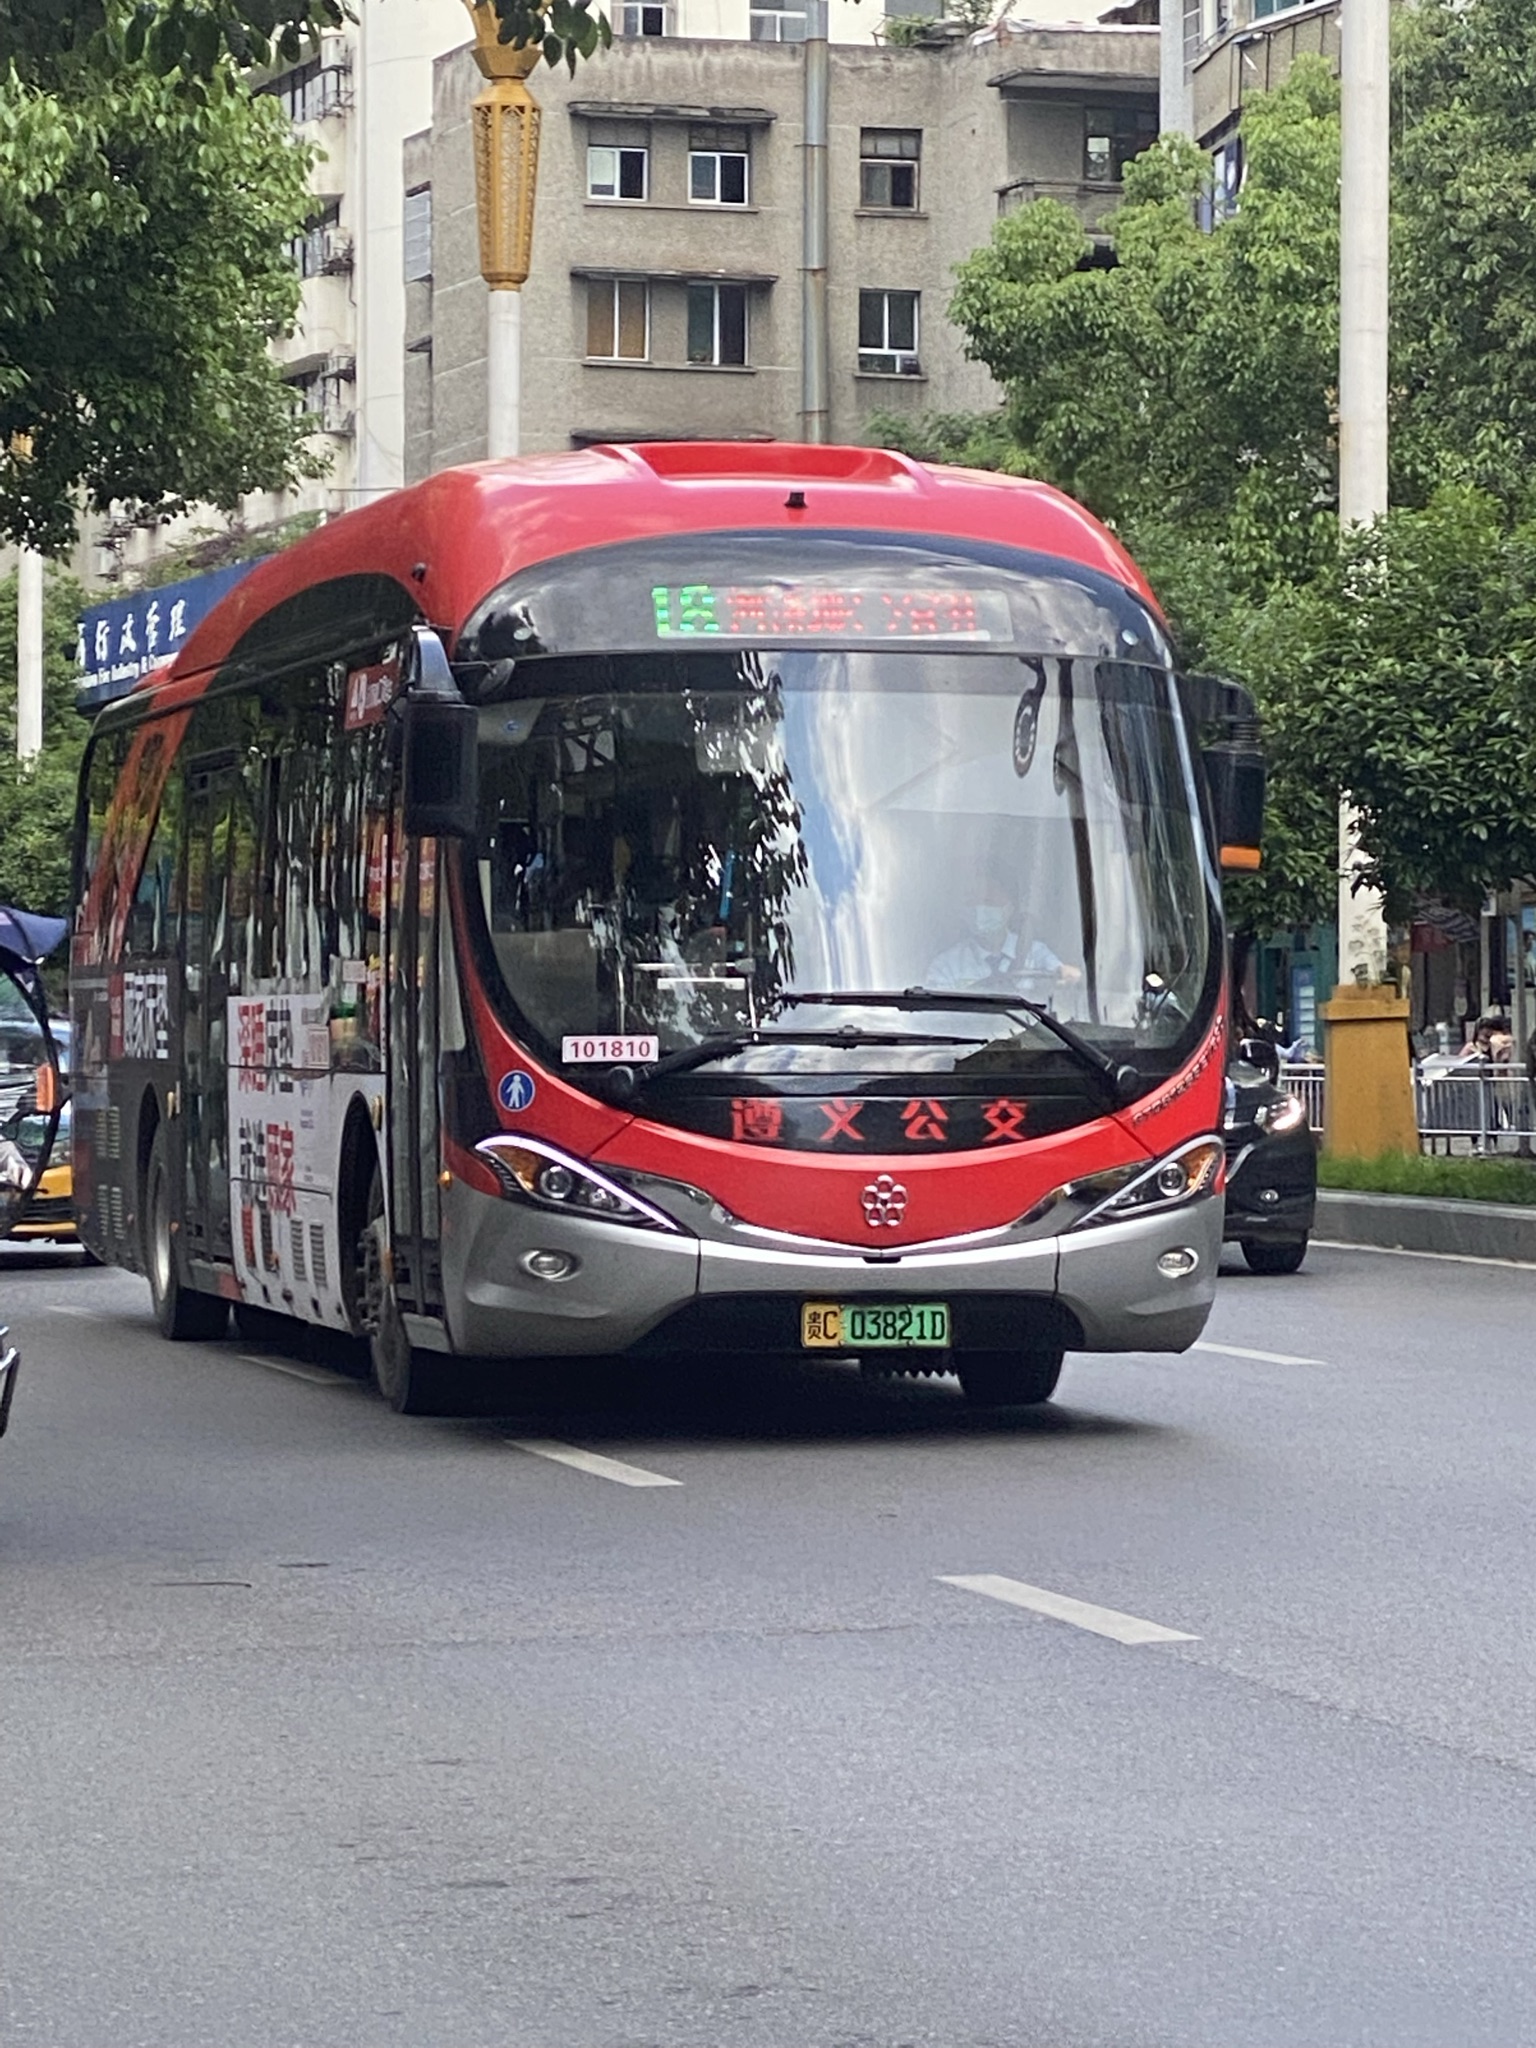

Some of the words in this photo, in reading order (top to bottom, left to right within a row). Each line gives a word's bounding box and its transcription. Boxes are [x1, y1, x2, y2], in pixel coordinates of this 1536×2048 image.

[570, 1041, 651, 1058] 101810
[730, 1098, 1027, 1142] 遵义公交
